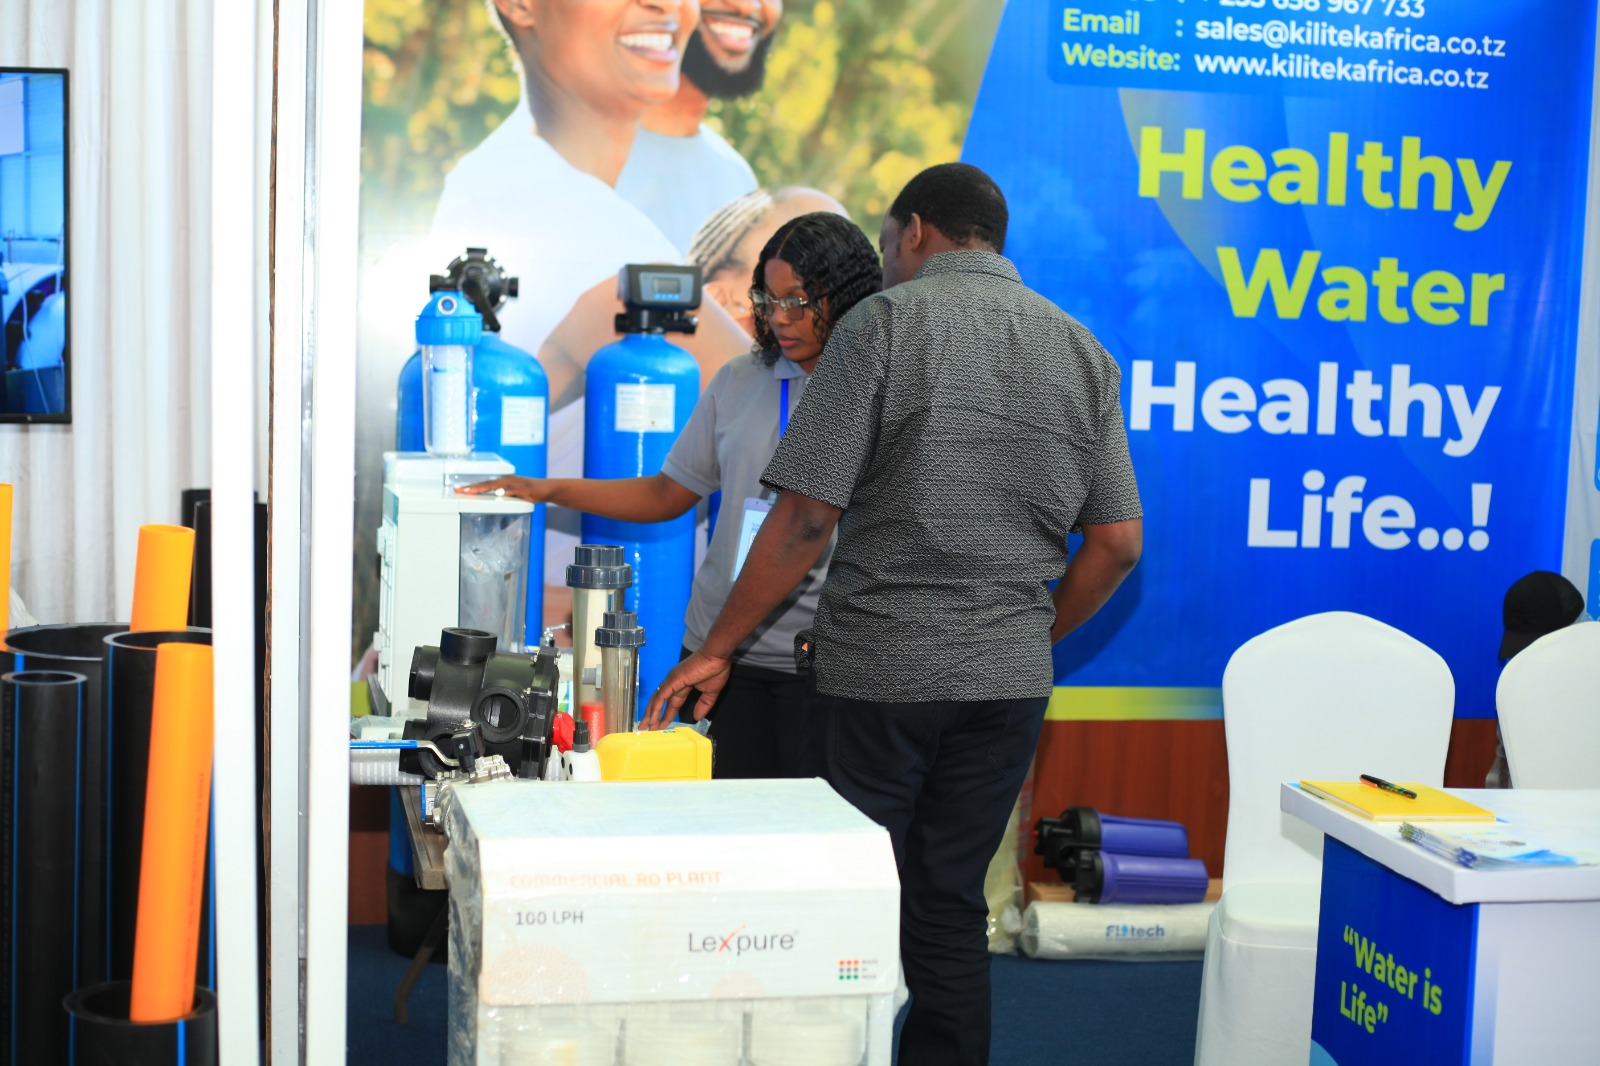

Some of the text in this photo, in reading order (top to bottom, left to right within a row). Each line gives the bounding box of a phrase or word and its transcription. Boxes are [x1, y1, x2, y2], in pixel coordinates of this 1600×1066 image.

[1064, 8, 1140, 35] Email
[1195, 16, 1506, 57] sales@kilitekafrica.co.tz
[1062, 42, 1489, 89] Website: www.kilitekafrica.co.tz
[1138, 126, 1512, 232] Healthy
[1216, 247, 1504, 326] Water
[1130, 360, 1501, 457] Healthy
[510, 871, 722, 888] COMMERCIAL RO PLANT
[515, 911, 584, 926] 100 LPH
[688, 927, 795, 956] Lexpure
[1343, 925, 1443, 1016] “Water is
[1340, 980, 1389, 1034] Life”
